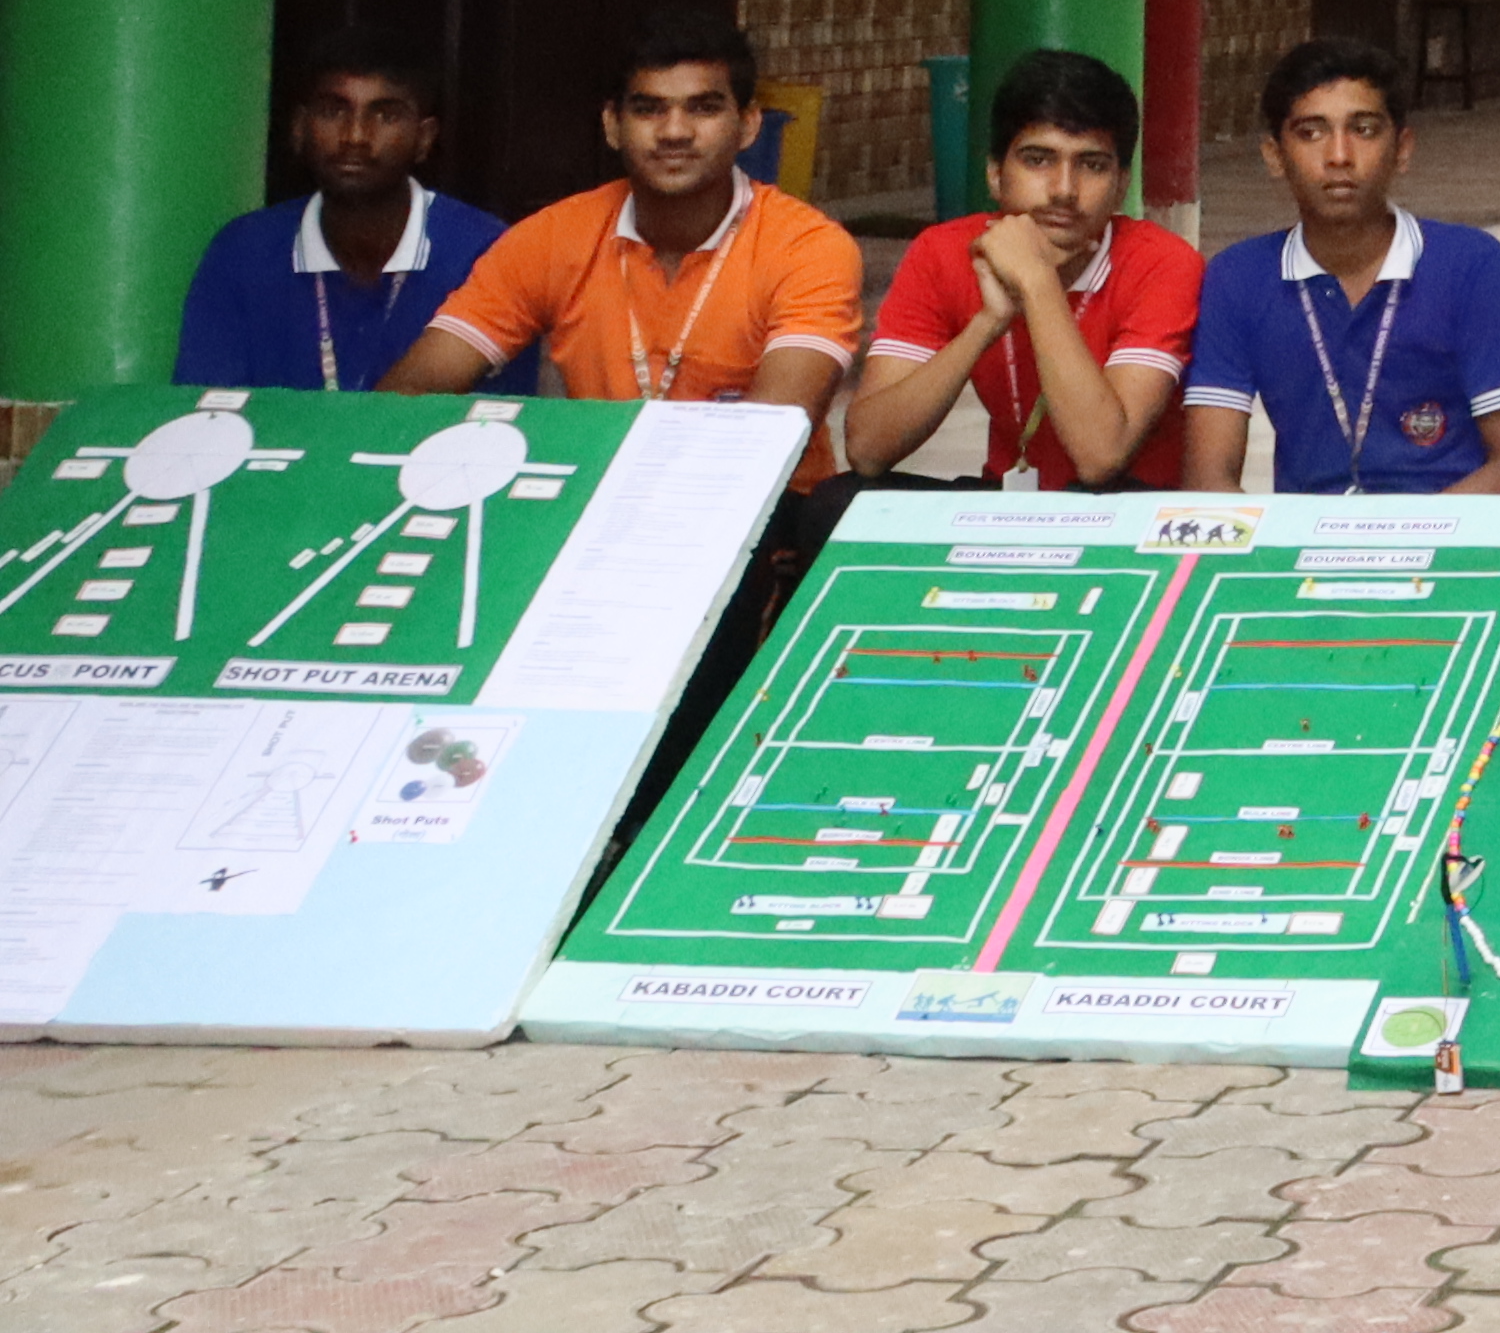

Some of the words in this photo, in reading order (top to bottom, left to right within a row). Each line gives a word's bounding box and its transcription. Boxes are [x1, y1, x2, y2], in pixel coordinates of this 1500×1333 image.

[990, 515, 1055, 524] WOMENS
[1060, 515, 1112, 524] GROUP
[1319, 522, 1350, 530] FOR
[1353, 523, 1397, 531] MENS
[1401, 523, 1453, 531] GROUP
[954, 550, 1034, 559] BOUNDARY
[1040, 551, 1075, 560] LINE
[1303, 555, 1386, 563] BOUNDARY
[1390, 555, 1425, 563] LINE
[73, 663, 158, 680] POINT
[224, 665, 298, 683] SHOT
[302, 669, 356, 685] PUT
[360, 670, 450, 687] ARENA
[275, 708, 297, 733] PUT
[370, 813, 411, 826] Shot
[412, 815, 450, 827] Puts
[631, 981, 758, 998] KABADDI
[765, 984, 863, 1001] COURT
[1055, 992, 1181, 1008] KABADDI
[1189, 995, 1288, 1011] COURT
